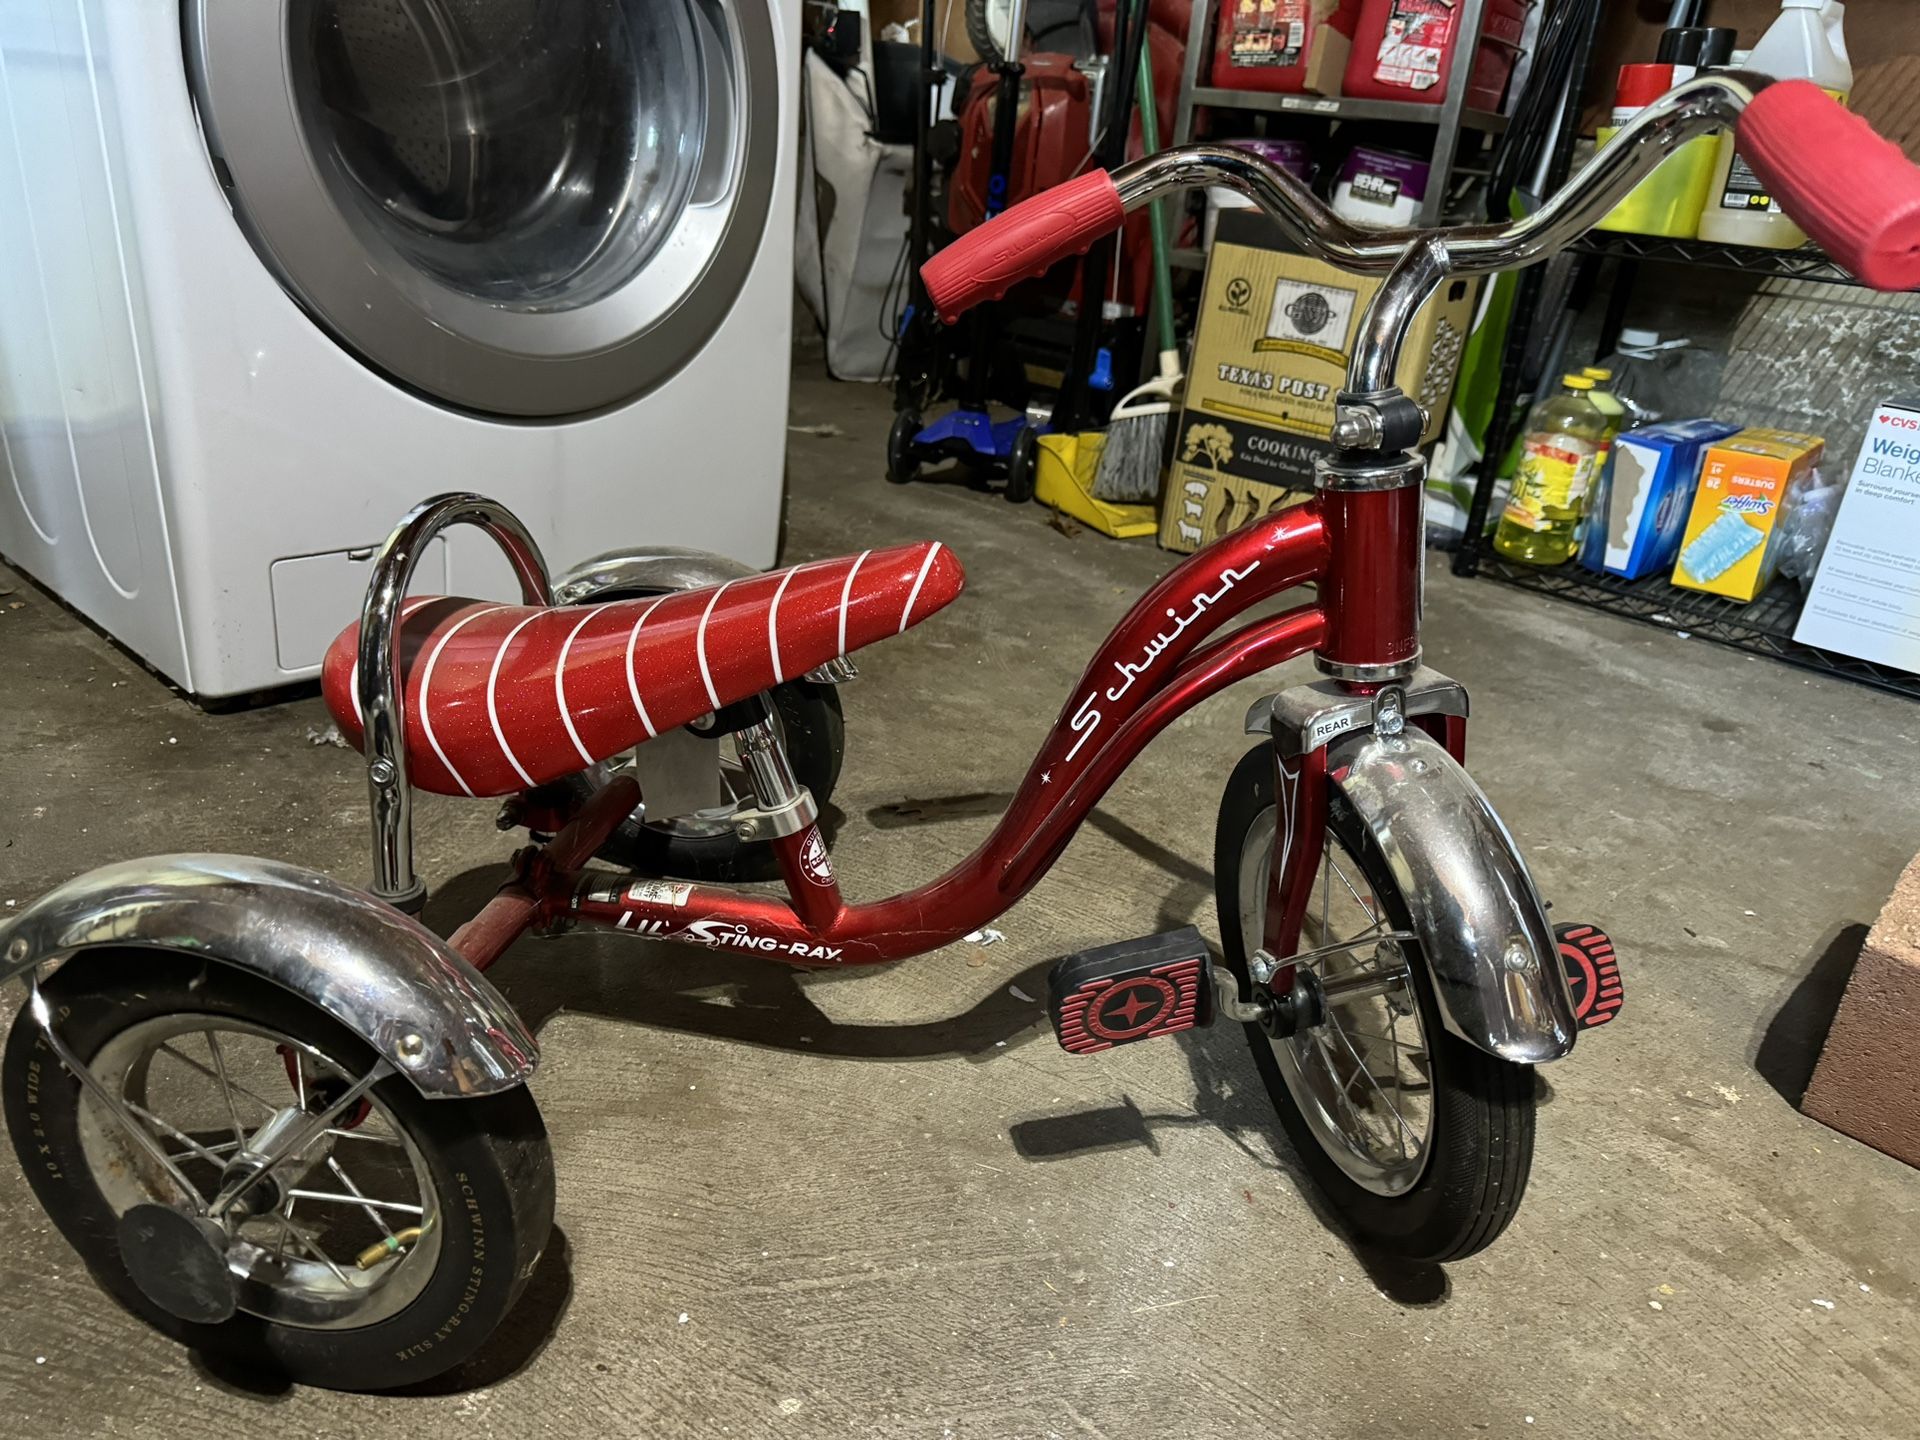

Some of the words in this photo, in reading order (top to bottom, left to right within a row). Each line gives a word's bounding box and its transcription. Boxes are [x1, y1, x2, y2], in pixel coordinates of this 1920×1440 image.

[1353, 173, 1384, 192] BEHR
[1218, 363, 1274, 391] TEXAS
[1279, 377, 1330, 401] POST
[1891, 417, 1918, 430] CVS
[1247, 435, 1321, 464] COOKING
[1873, 437, 1920, 465] Weig
[1731, 475, 1775, 490] DUSTERS
[1723, 495, 1774, 514] Swiffer
[1065, 560, 1260, 762] Schwinn
[1316, 717, 1350, 736] REAR
[27, 1060, 41, 1104] WIDE
[455, 1171, 485, 1261] SCHWINN
[434, 1265, 484, 1342] STING-RAY
[396, 1338, 433, 1362] SLIK
